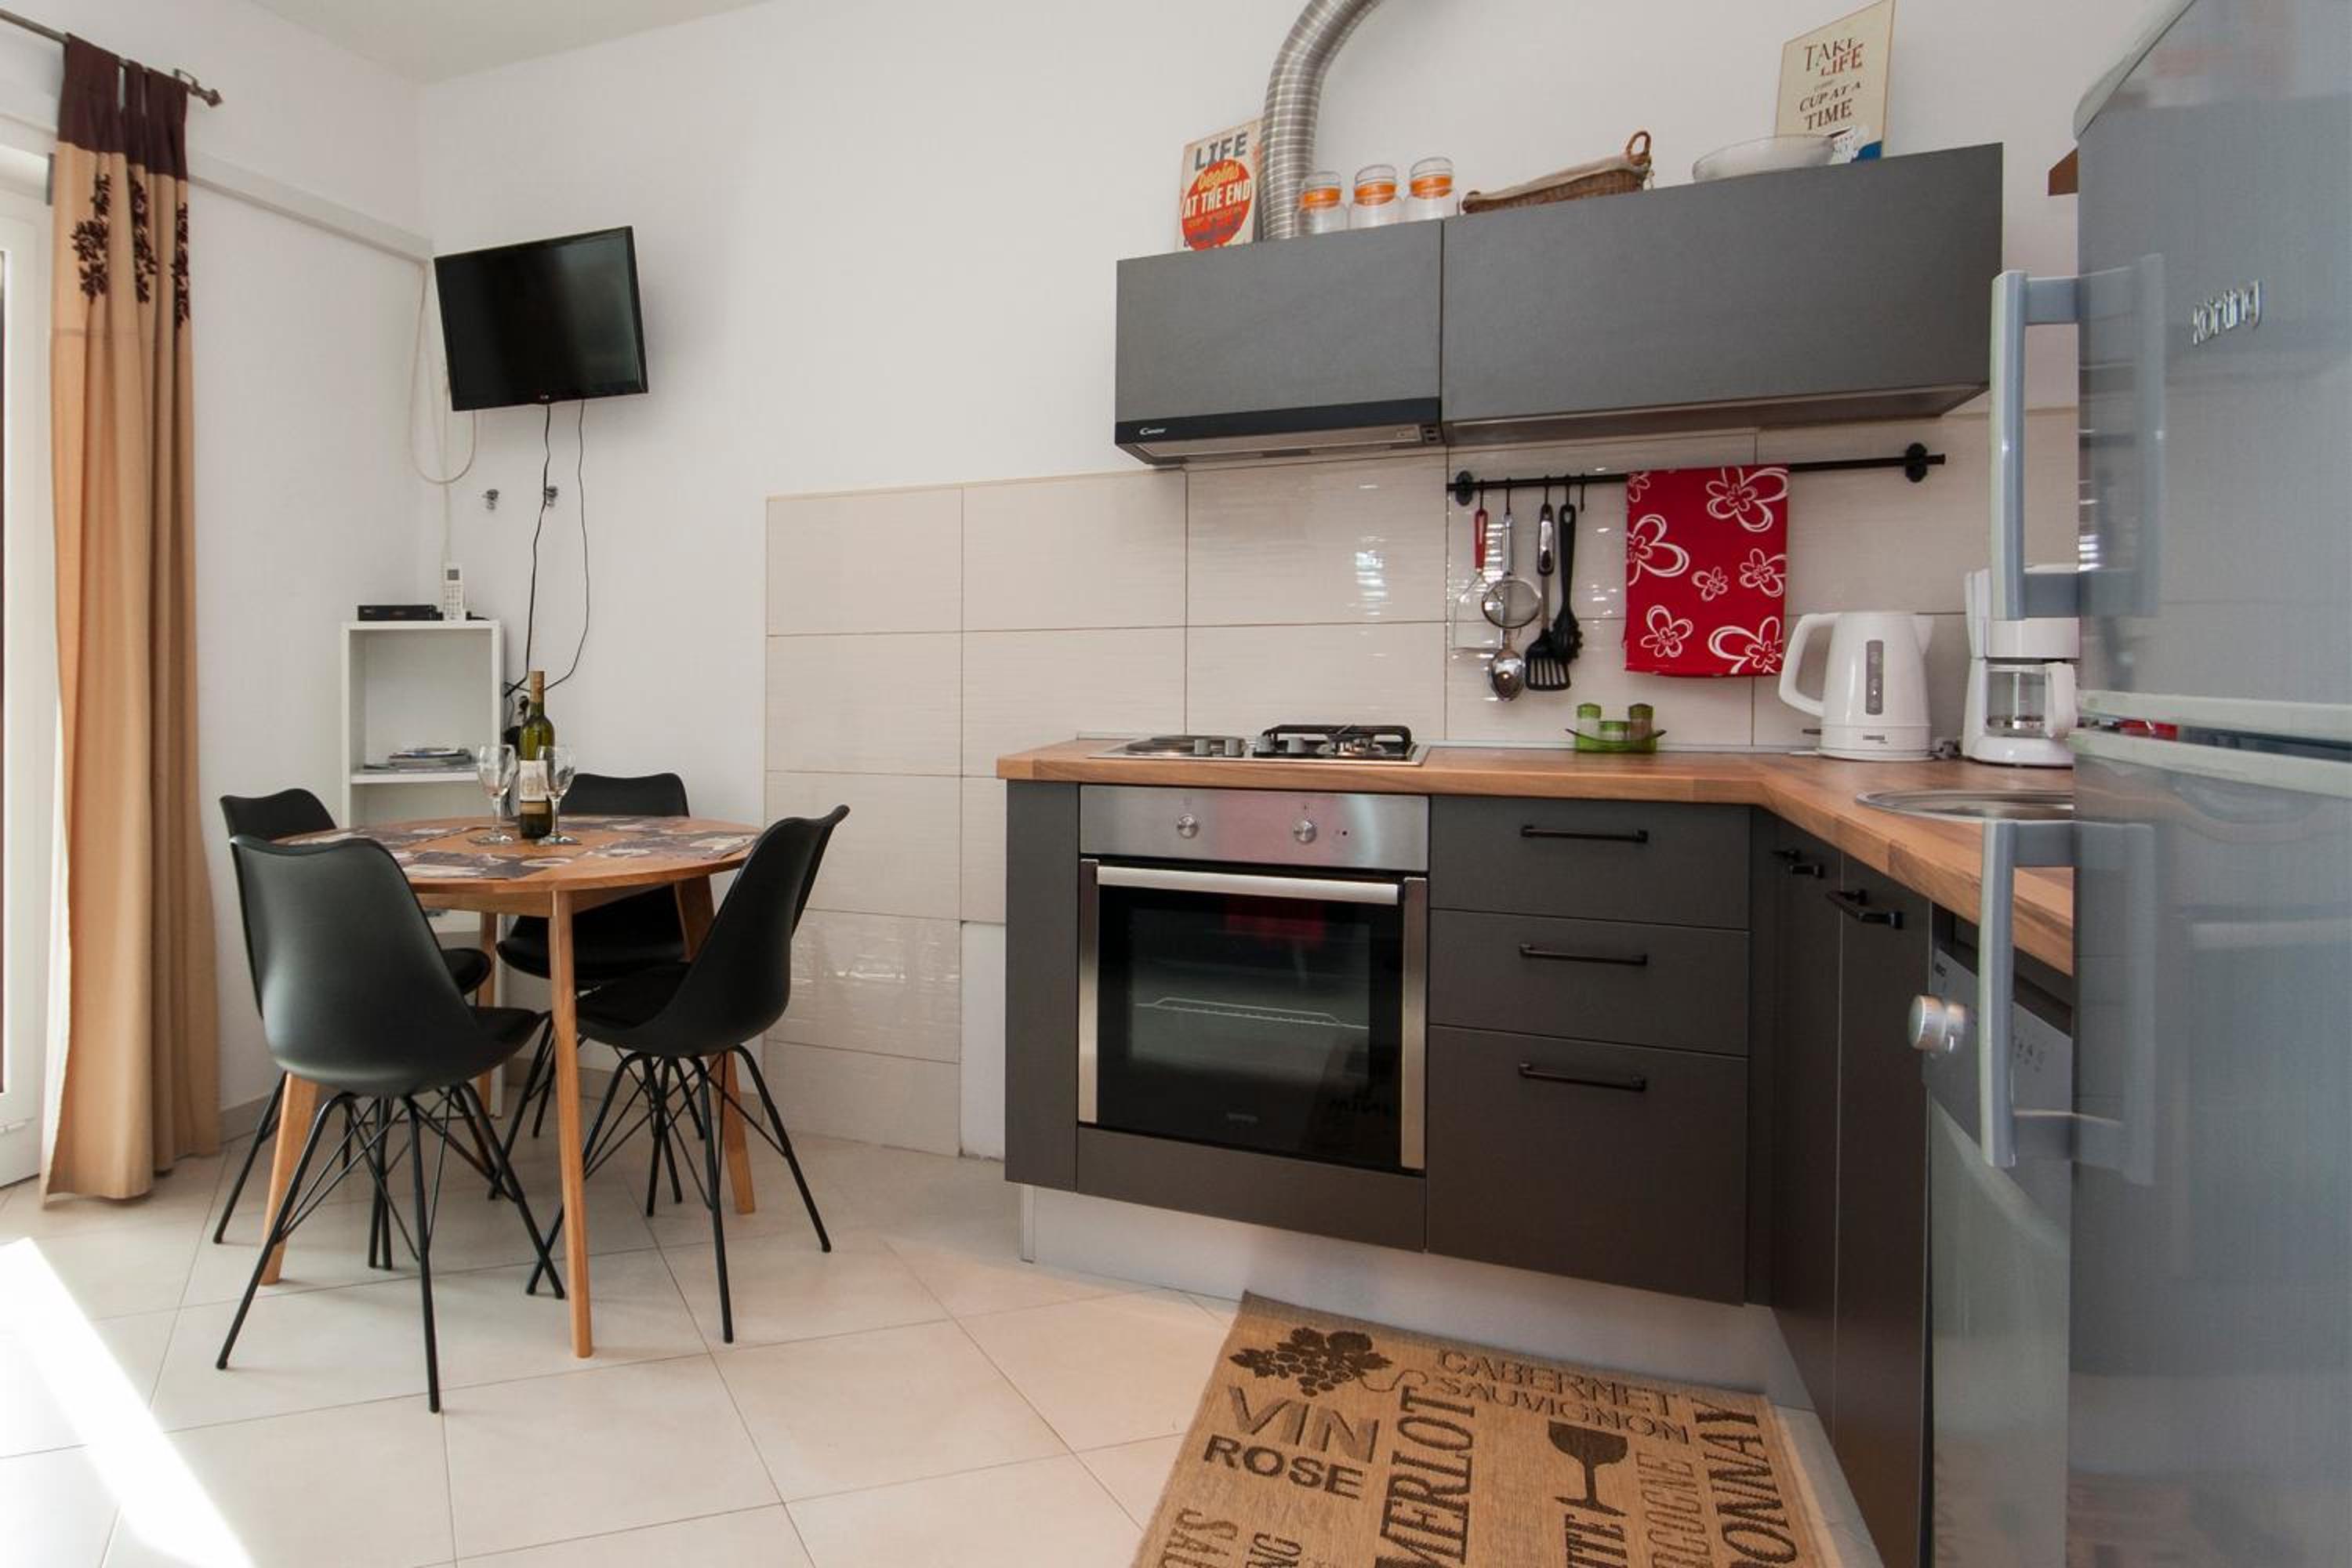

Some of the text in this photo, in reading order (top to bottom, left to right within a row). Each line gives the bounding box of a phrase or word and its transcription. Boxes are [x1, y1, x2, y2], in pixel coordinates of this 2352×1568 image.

[1804, 37, 1857, 72] TAKE
[1820, 42, 1864, 77] LIFE
[1798, 91, 1828, 113] CUP
[1831, 84, 1849, 100] AT
[1851, 81, 1861, 91] A
[1804, 98, 1853, 132] TIME
[1194, 132, 1248, 171] LIFE
[1184, 195, 1200, 220] AT
[1201, 185, 1225, 215] THE
[1225, 178, 1252, 206] END
[1437, 1348, 1678, 1417] CABERNET
[1228, 1386, 1380, 1465] VIN
[1439, 1376, 1690, 1445] SAUVIGNON
[1203, 1434, 1364, 1501] ROSE
[1690, 1398, 1798, 1568] ONNAY
